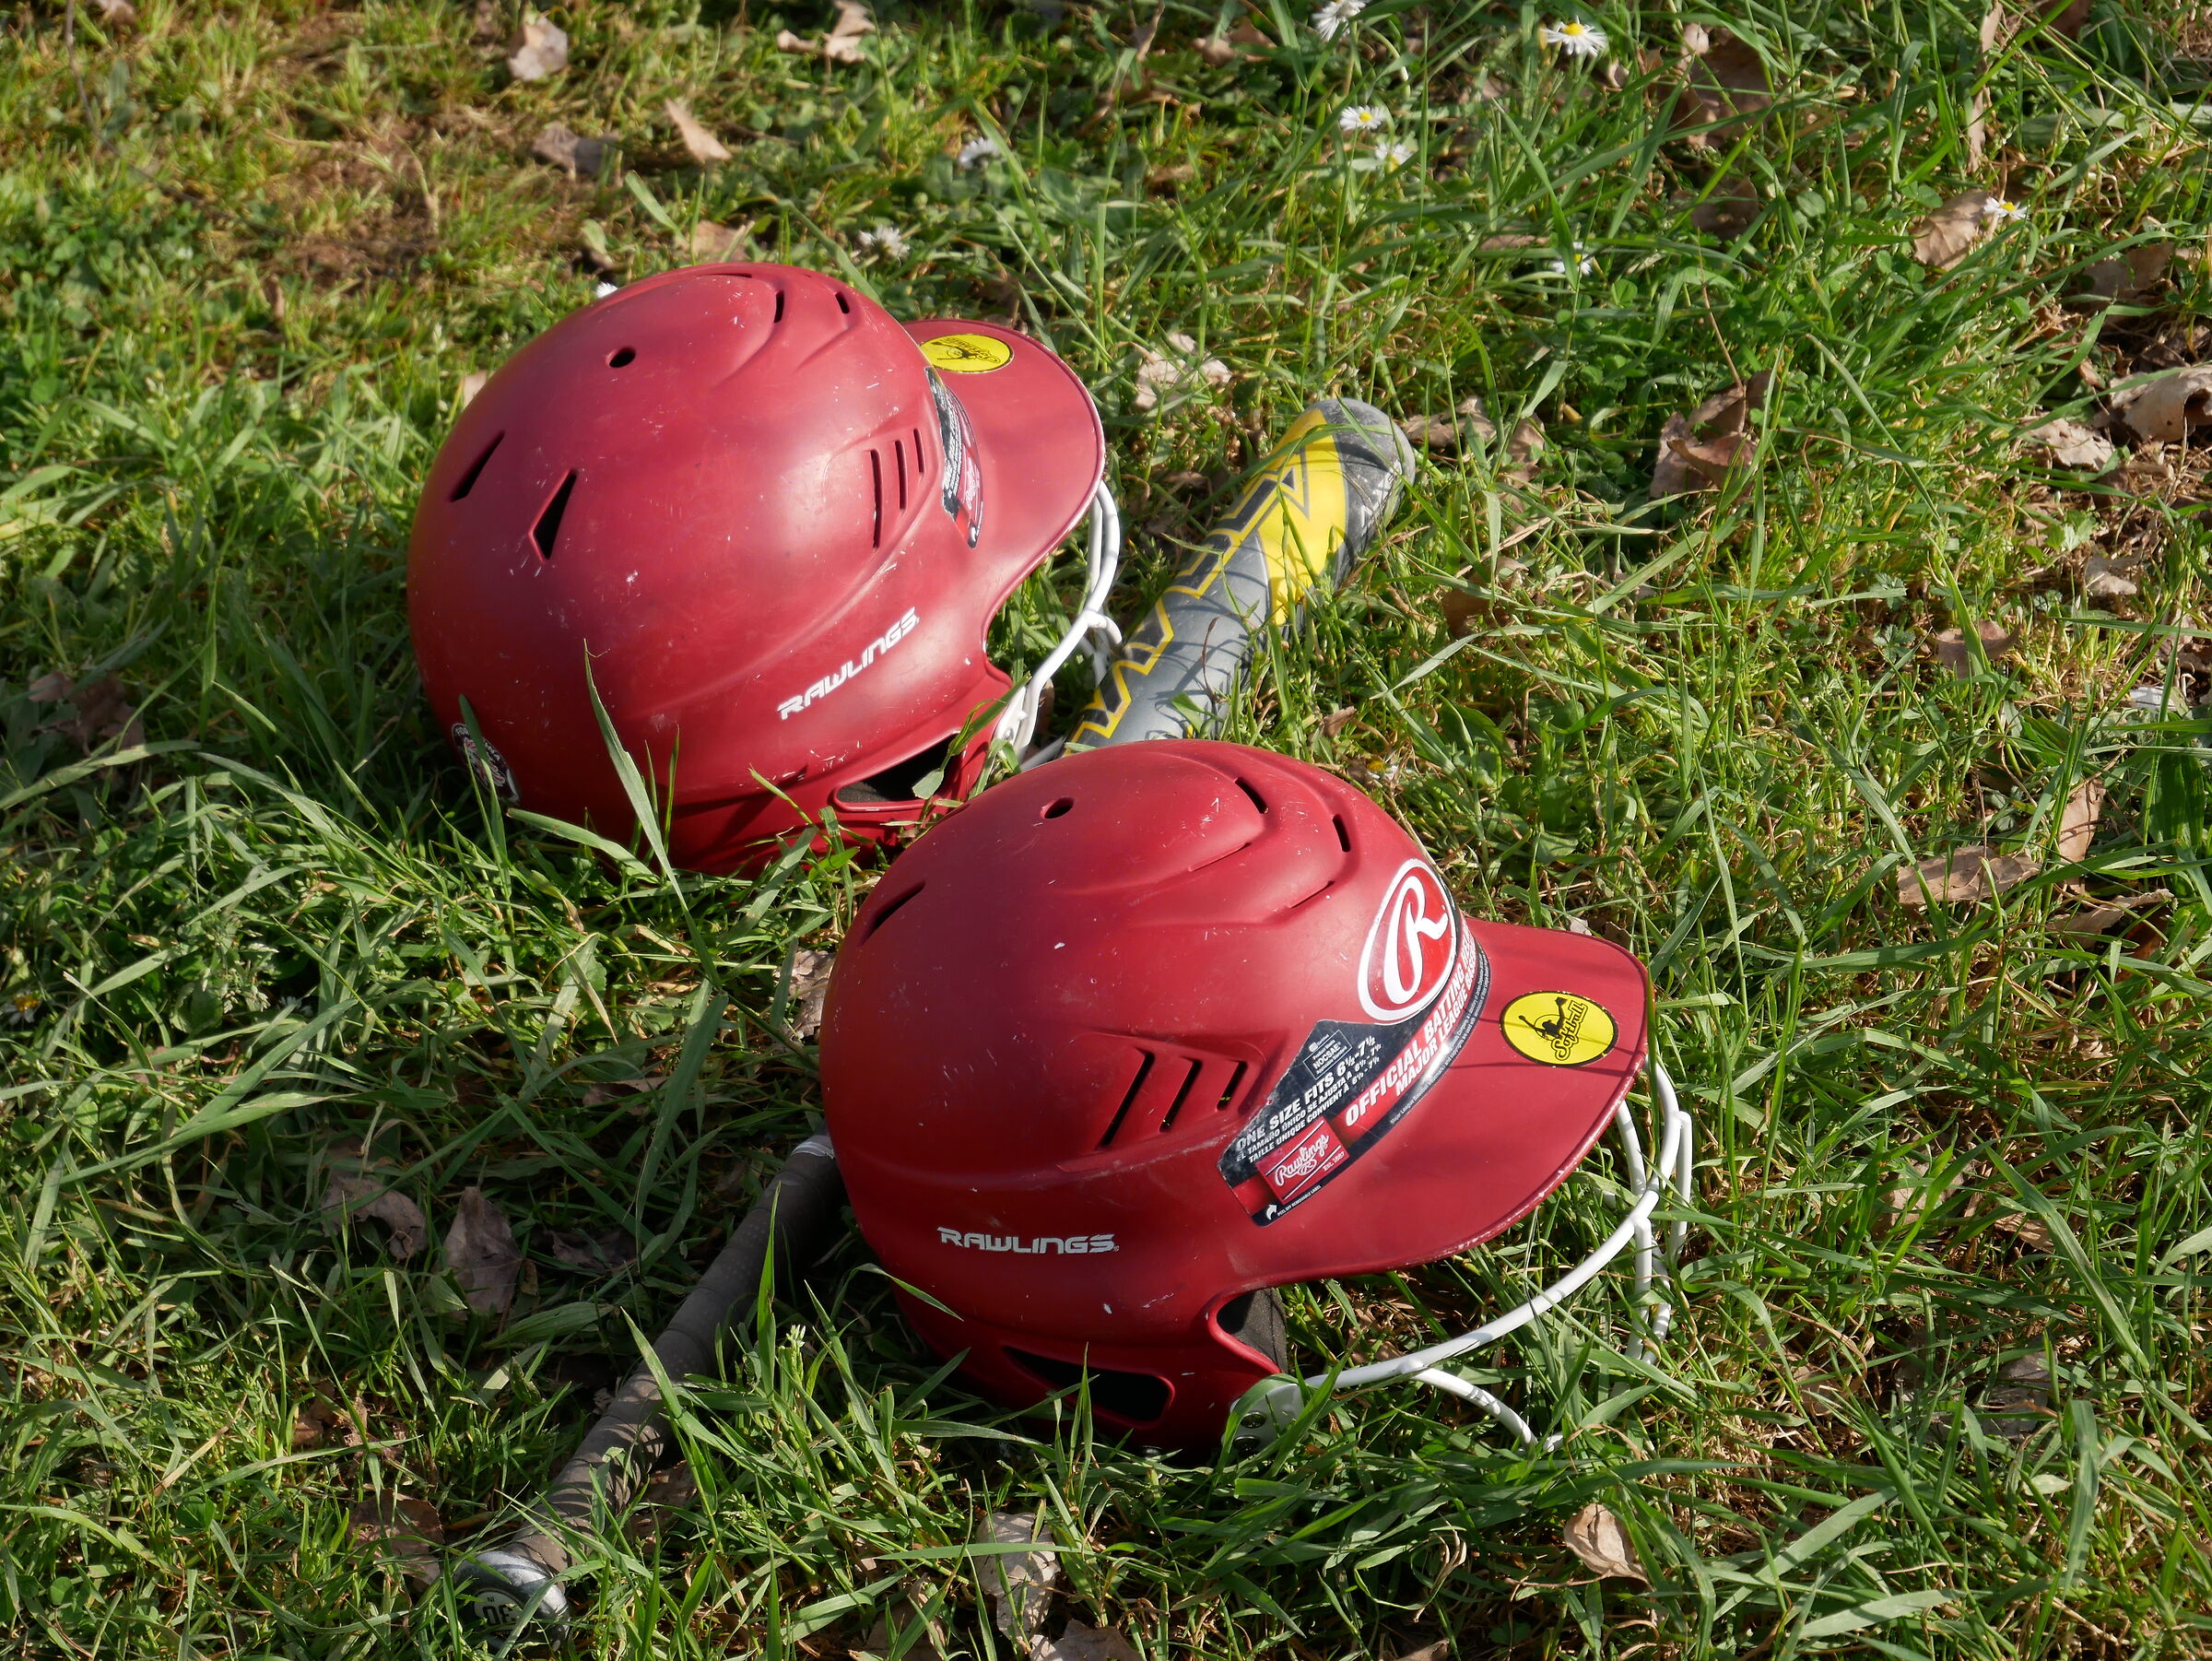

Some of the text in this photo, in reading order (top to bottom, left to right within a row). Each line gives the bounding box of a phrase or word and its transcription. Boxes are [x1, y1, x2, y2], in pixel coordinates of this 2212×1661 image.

[777, 607, 918, 720] RAWLINGS
[1346, 1039, 1422, 1126] OFFICIAL
[1423, 962, 1465, 1044] BATTING
[1395, 1037, 1438, 1097] MAJOR
[1438, 983, 1468, 1043] LEAGUE
[1236, 1125, 1265, 1151] ONE
[1269, 1099, 1301, 1130] SIZE
[1304, 1072, 1335, 1104] FITS
[1249, 1141, 1276, 1163] TAILLE
[1277, 1120, 1306, 1144] UNIQUE
[1307, 1089, 1343, 1123] CONVIENT
[1307, 1101, 1318, 1113] SE
[1318, 1077, 1346, 1104] AJUSTA
[1275, 1135, 1329, 1186] Rawlings
[936, 1226, 1115, 1255] RAWLINGS
